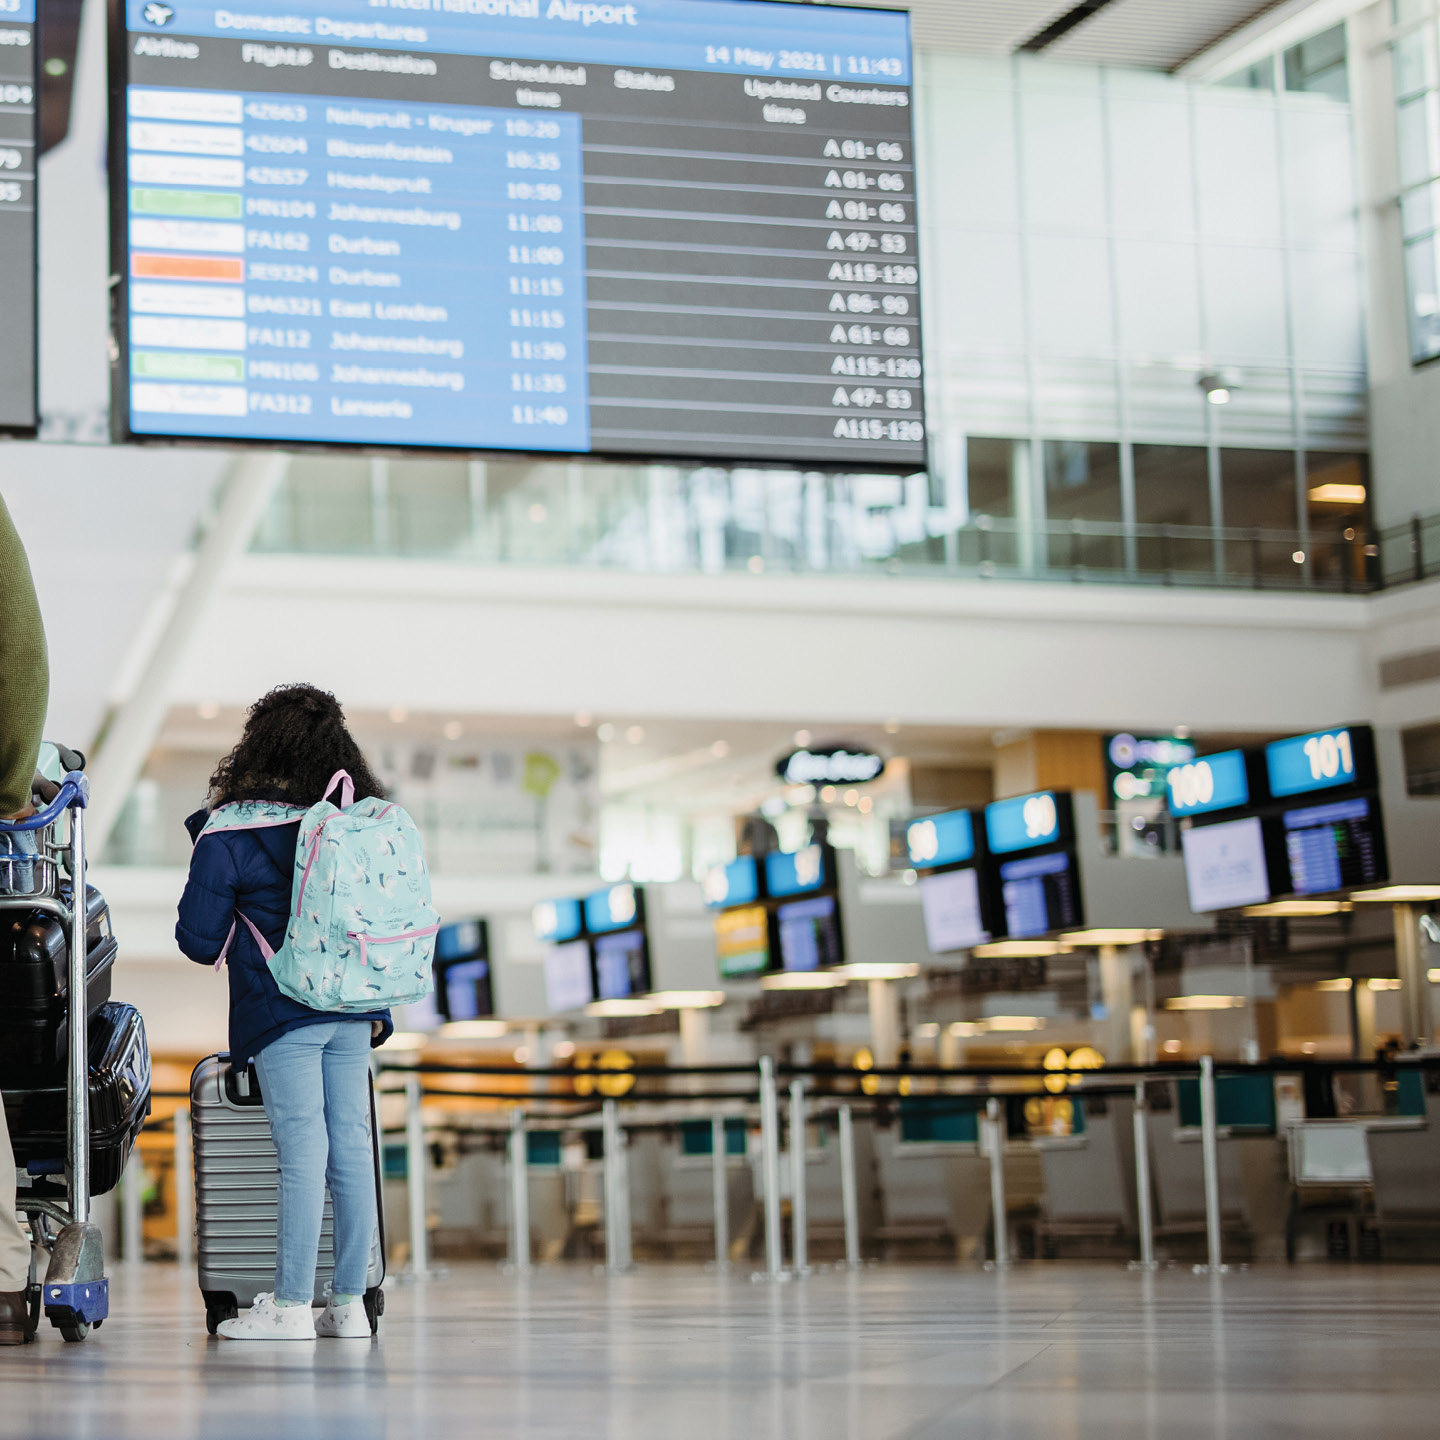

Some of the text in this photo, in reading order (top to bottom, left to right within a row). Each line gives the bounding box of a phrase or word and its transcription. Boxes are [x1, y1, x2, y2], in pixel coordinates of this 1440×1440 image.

[215, 11, 427, 42] Domestic Departures
[547, 3, 637, 26] Airport
[134, 37, 909, 106] Airline Flight# Destination Scheduled Status Updated Counters
[705, 46, 730, 64] 14
[734, 47, 774, 70] May
[778, 50, 827, 71] 2021
[848, 55, 902, 76] 11:43
[326, 106, 411, 130] Nelspruit
[429, 113, 493, 136] Kruger
[505, 119, 560, 139] 10:20
[327, 138, 453, 164] Bloemfontein
[506, 151, 561, 171] 10:35
[327, 201, 461, 231] Johannesburg
[508, 213, 563, 233] 11:00
[247, 230, 917, 285] FA162 Durban 11:00 A115-120
[329, 266, 401, 288] Durban
[509, 277, 563, 297] 11:15
[329, 298, 372, 319] East
[375, 300, 447, 323] London
[510, 309, 564, 329] 11:15
[249, 327, 921, 378] FA112 Johannesburg 11:30 A115-120
[331, 363, 465, 391] Johannesburg
[511, 373, 566, 393] 11:35
[249, 393, 311, 414] FA312
[512, 405, 567, 425] 11:40
[833, 418, 924, 441] A115-120
[1304, 731, 1353, 780] 101
[1167, 761, 1213, 808] 100
